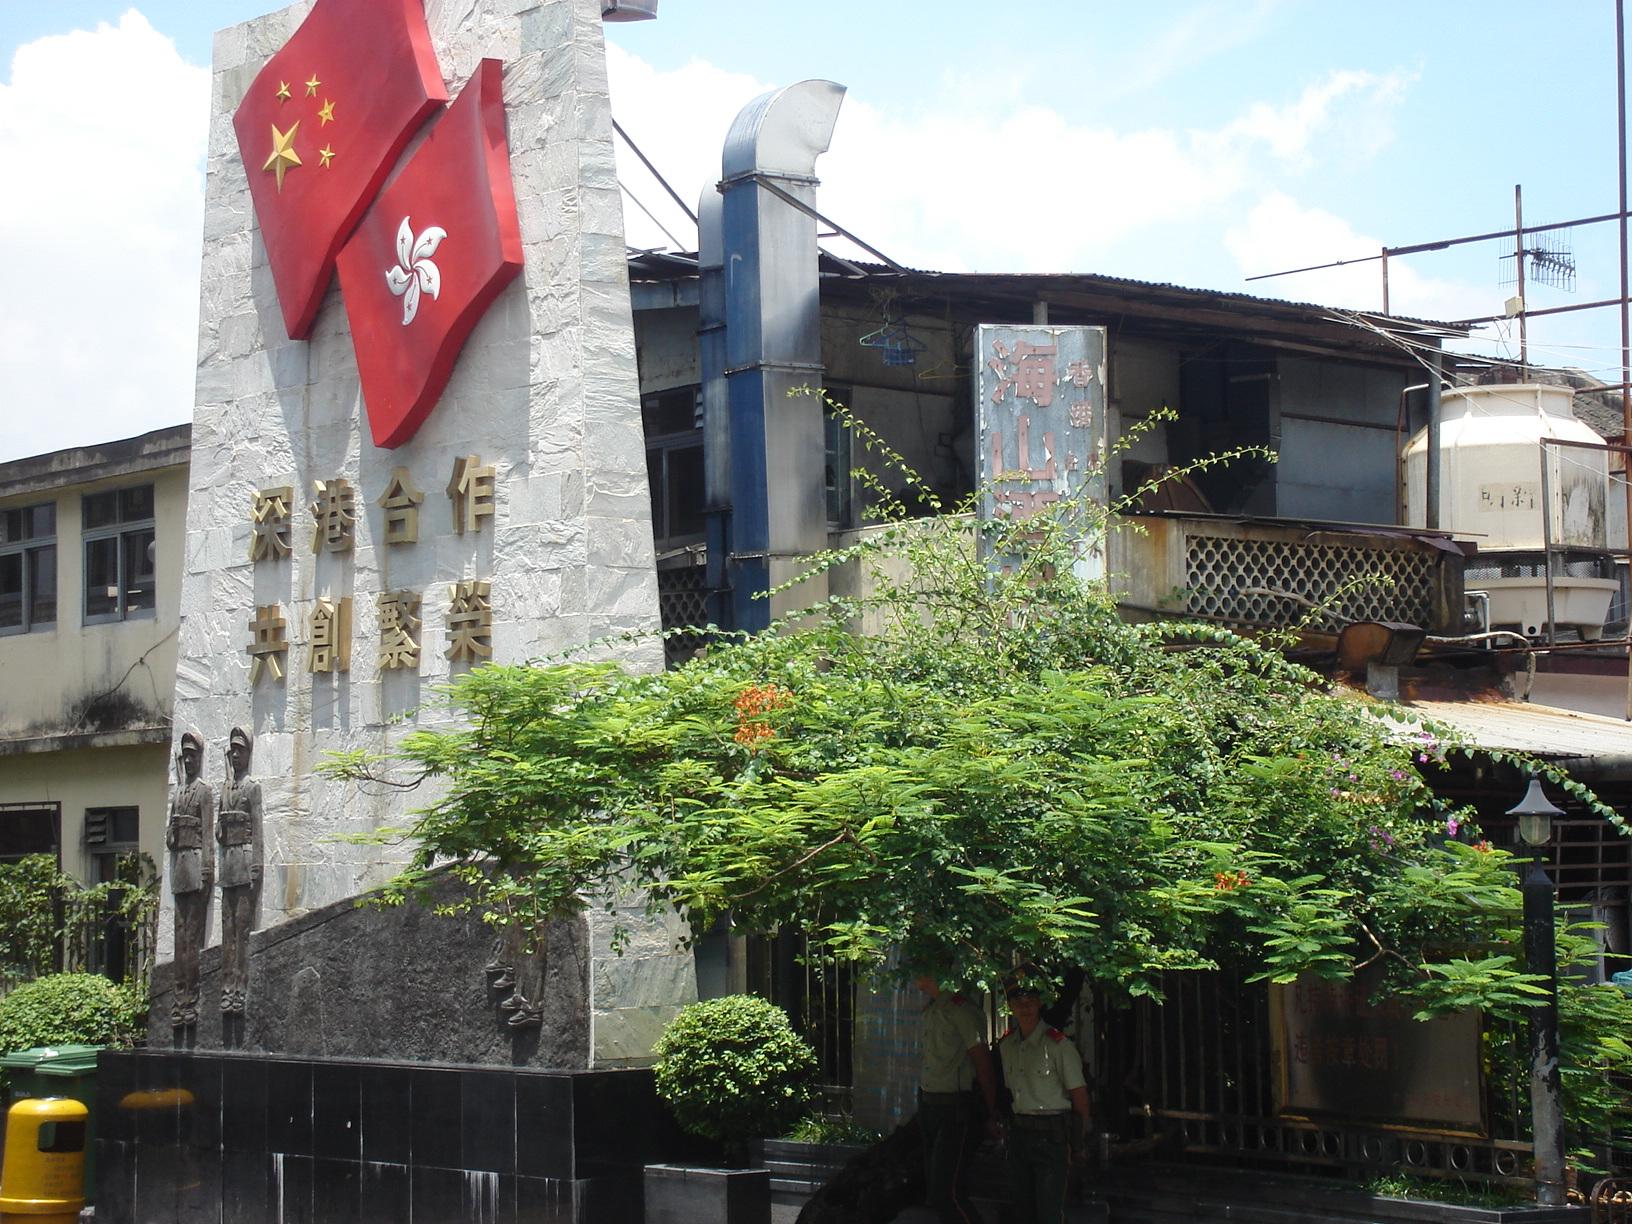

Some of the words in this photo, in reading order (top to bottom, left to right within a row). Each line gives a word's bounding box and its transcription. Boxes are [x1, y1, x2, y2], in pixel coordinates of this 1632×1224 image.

[248, 455, 495, 560] 深港合作
[246, 579, 492, 687] 共創繁榮
